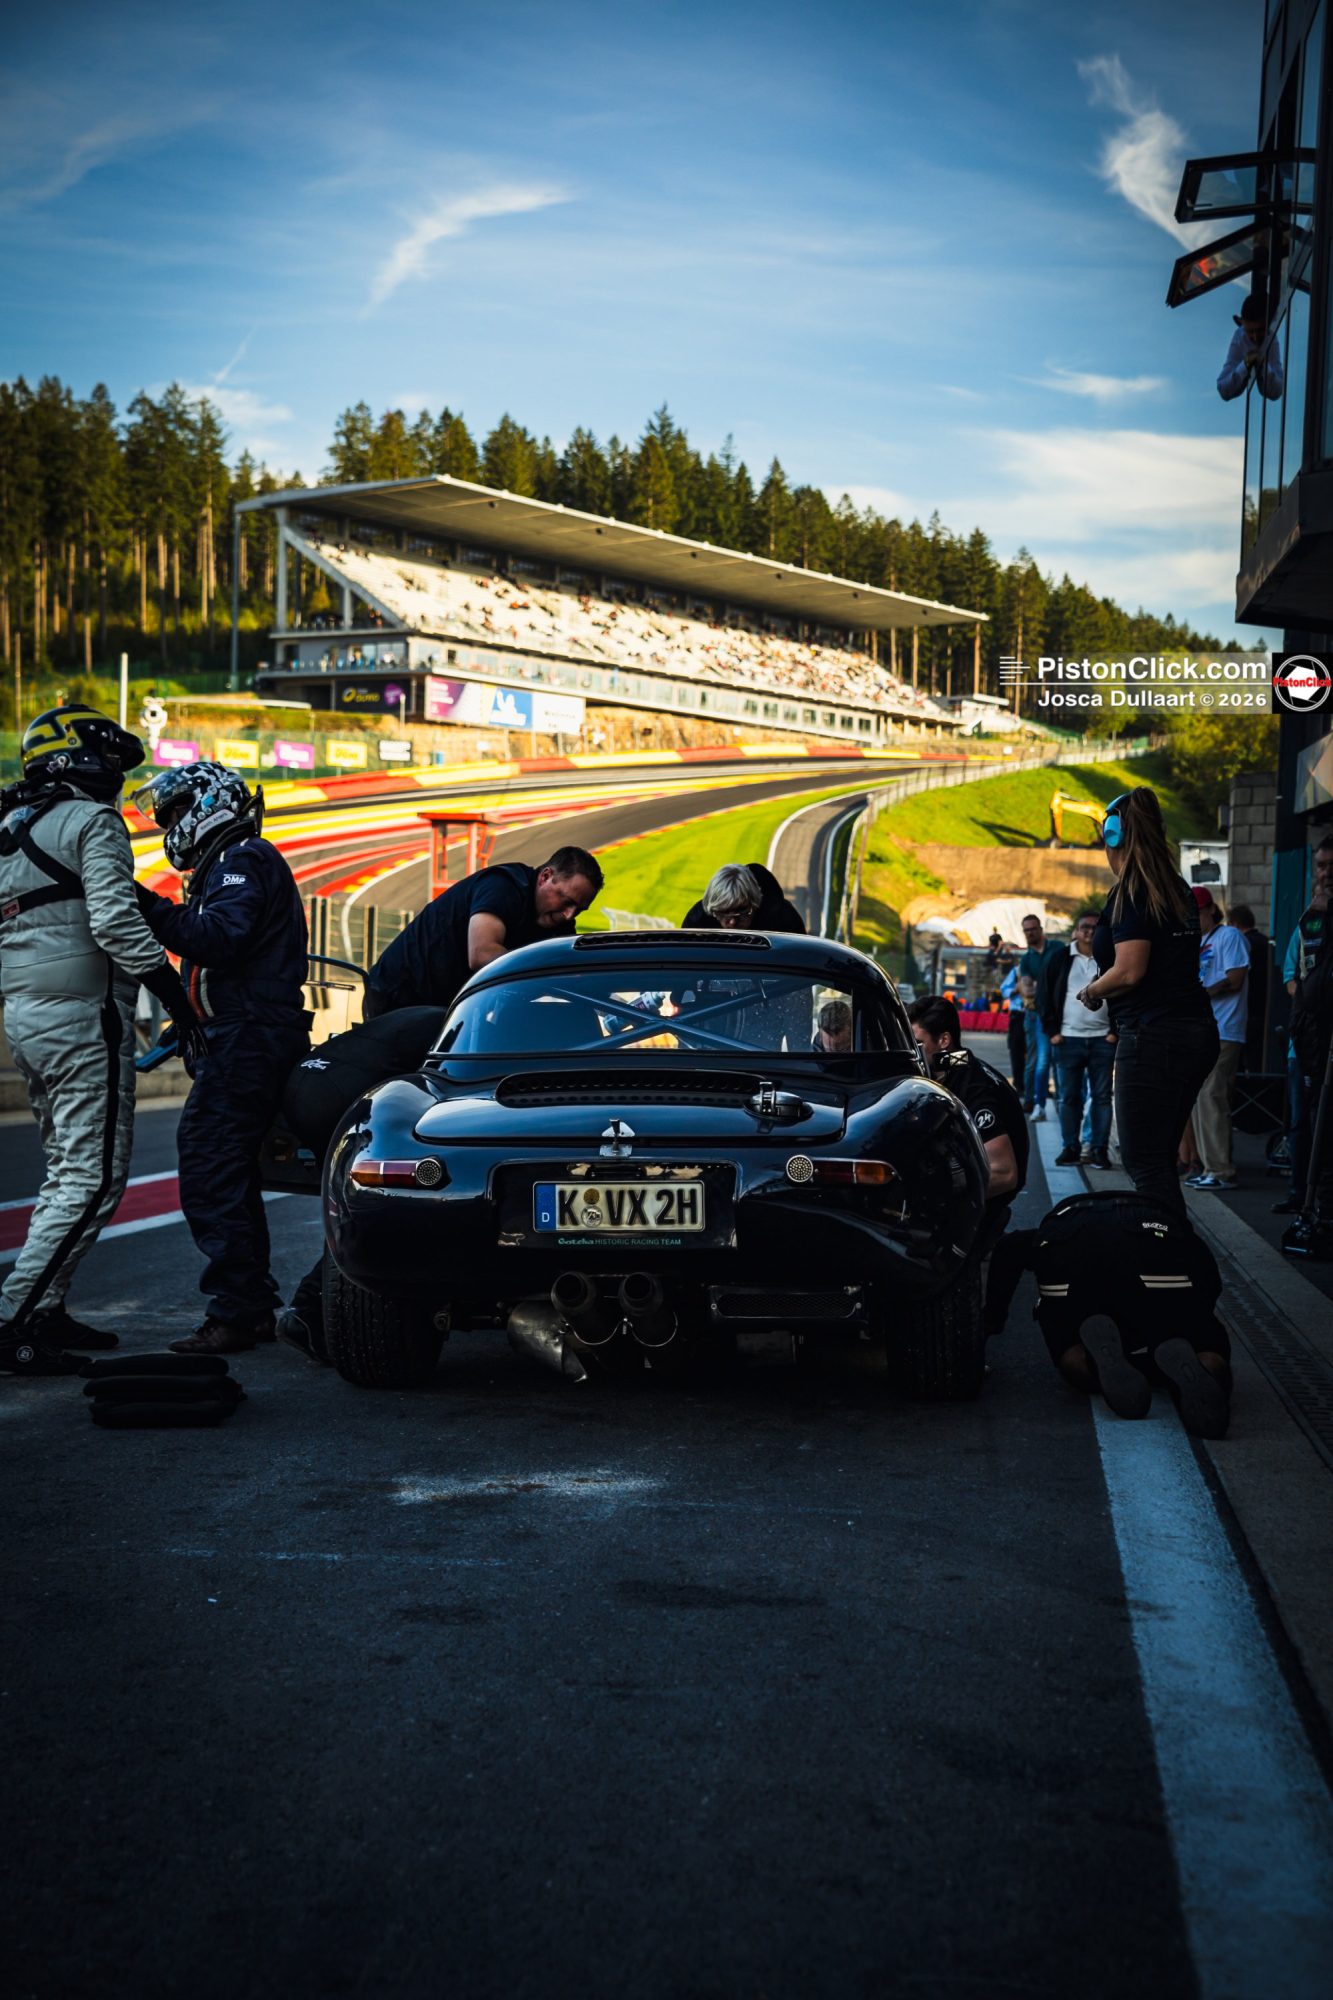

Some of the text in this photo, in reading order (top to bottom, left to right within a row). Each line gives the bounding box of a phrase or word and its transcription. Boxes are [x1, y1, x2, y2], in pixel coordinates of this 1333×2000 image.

[223, 874, 246, 886] OMP
[558, 1188, 698, 1226] K VX 2H
[541, 1212, 550, 1223] D
[594, 1238, 629, 1246] HISTORIC
[631, 1238, 660, 1246] RACING
[661, 1238, 682, 1246] TEAM
